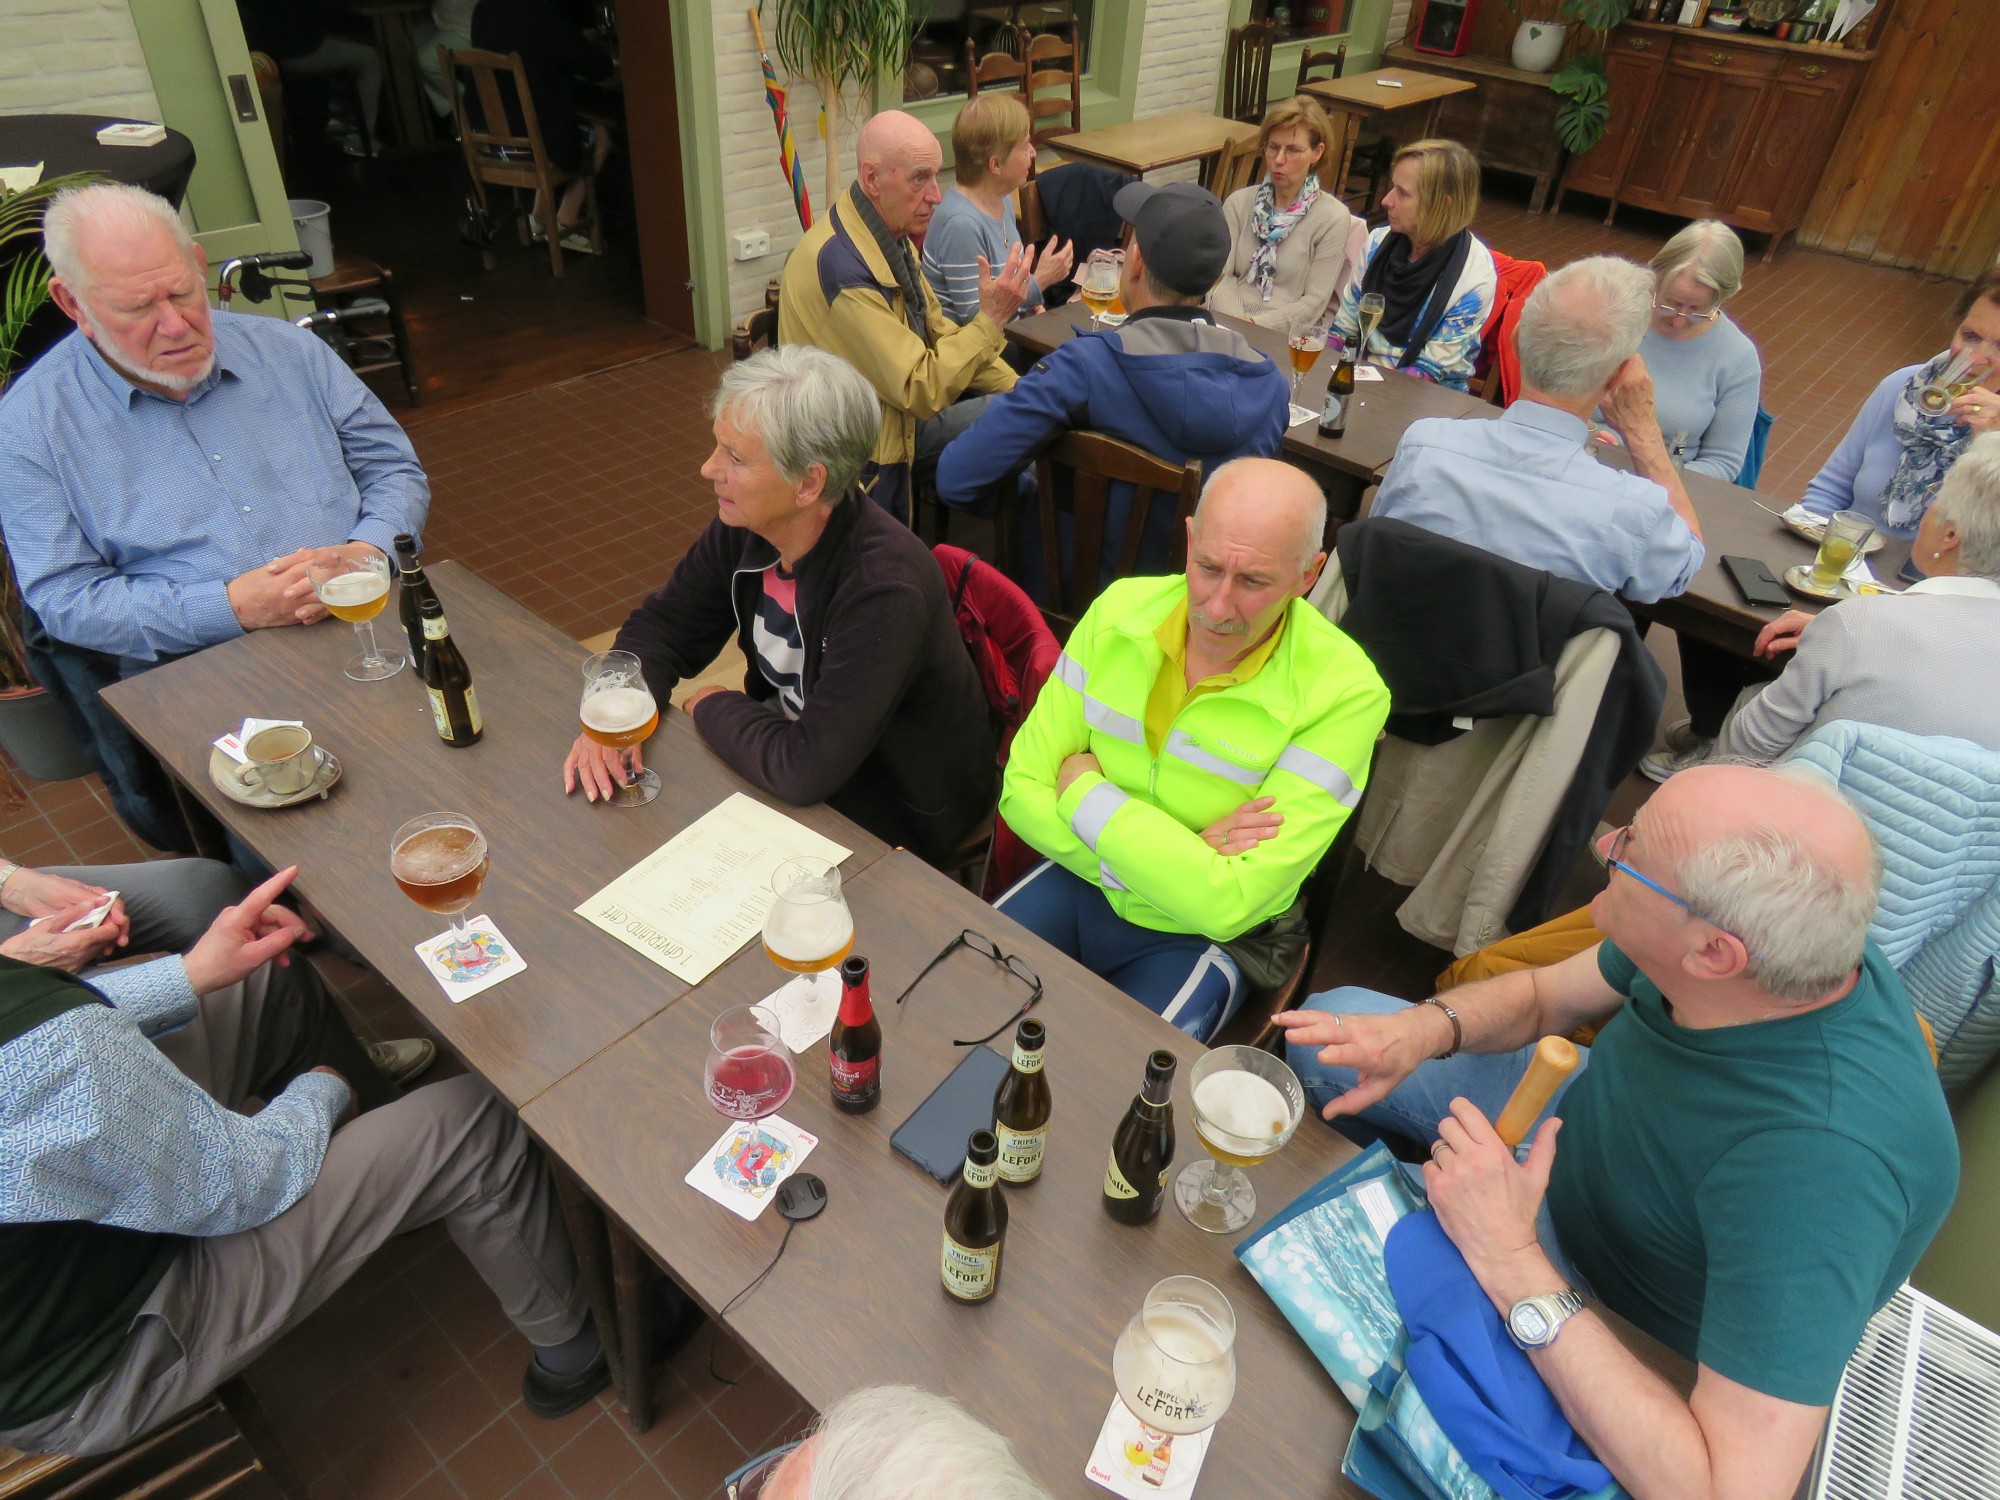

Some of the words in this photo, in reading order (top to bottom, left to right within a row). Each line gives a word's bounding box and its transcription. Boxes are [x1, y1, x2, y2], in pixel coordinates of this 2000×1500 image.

[599, 904, 629, 925] CAFÉ
[625, 920, 685, 960] GAVERLAND
[1011, 1137, 1039, 1146] TRIPEL
[1001, 1150, 1042, 1166] LEFORT
[951, 1248, 980, 1264] TRIPEL
[944, 1258, 987, 1283] LEFORT
[1136, 1385, 1195, 1420] LEFORT
[1154, 1388, 1180, 1404] TRIPEL
[1090, 1465, 1112, 1482] Duvel
[1147, 1460, 1167, 1475] Duvel
